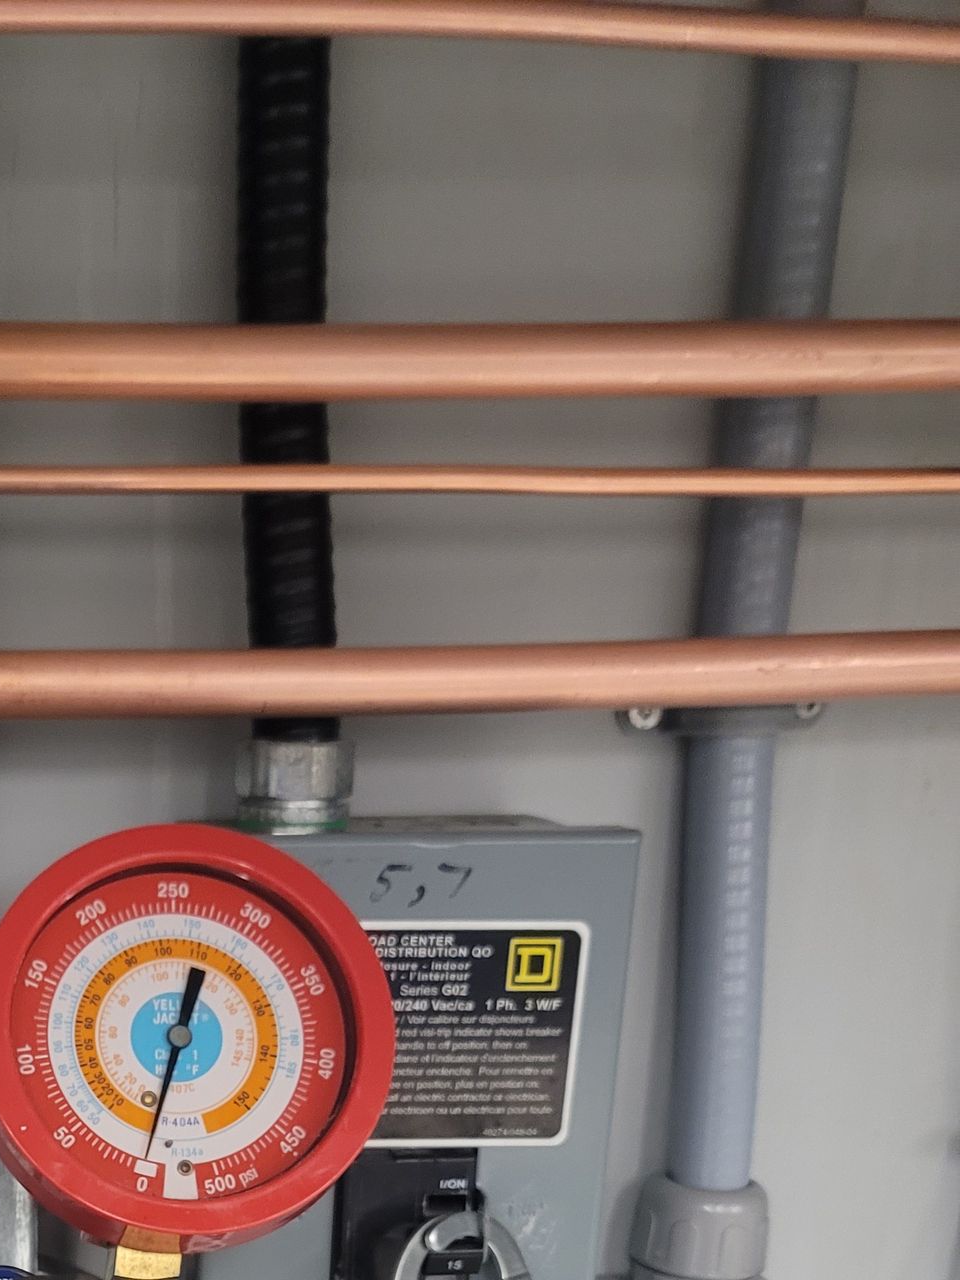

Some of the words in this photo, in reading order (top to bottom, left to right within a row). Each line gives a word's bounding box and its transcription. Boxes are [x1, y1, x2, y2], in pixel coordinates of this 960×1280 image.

[157, 882, 188, 898] 250
[75, 899, 106, 926] 200
[240, 902, 271, 929] 300
[400, 936, 454, 946] CENTER
[154, 947, 172, 956] 100
[124, 956, 138, 968] 90
[25, 960, 48, 989] 150
[102, 973, 116, 985] 80
[225, 966, 242, 981] 120
[300, 965, 325, 996] 350
[400, 985, 438, 996] Series
[442, 985, 469, 996] G02
[91, 994, 101, 1006] 70
[524, 1001, 532, 1010] 3
[253, 1000, 264, 1017] 130
[84, 1018, 94, 1029] 60
[84, 1038, 94, 1051] 50
[16, 1044, 36, 1076] 100
[260, 1045, 270, 1061] 140
[89, 1057, 97, 1068] 40
[318, 1048, 335, 1080] 400
[94, 1072, 105, 1084] 30
[102, 1084, 114, 1096] 20
[112, 1095, 124, 1106] 10
[234, 1091, 250, 1107] 150
[161, 1118, 200, 1128] R-404A
[53, 1126, 76, 1148] 50
[280, 1125, 306, 1155] 450
[136, 1176, 148, 1192] 0
[204, 1174, 236, 1195] 500
[239, 1166, 258, 1186] psi
